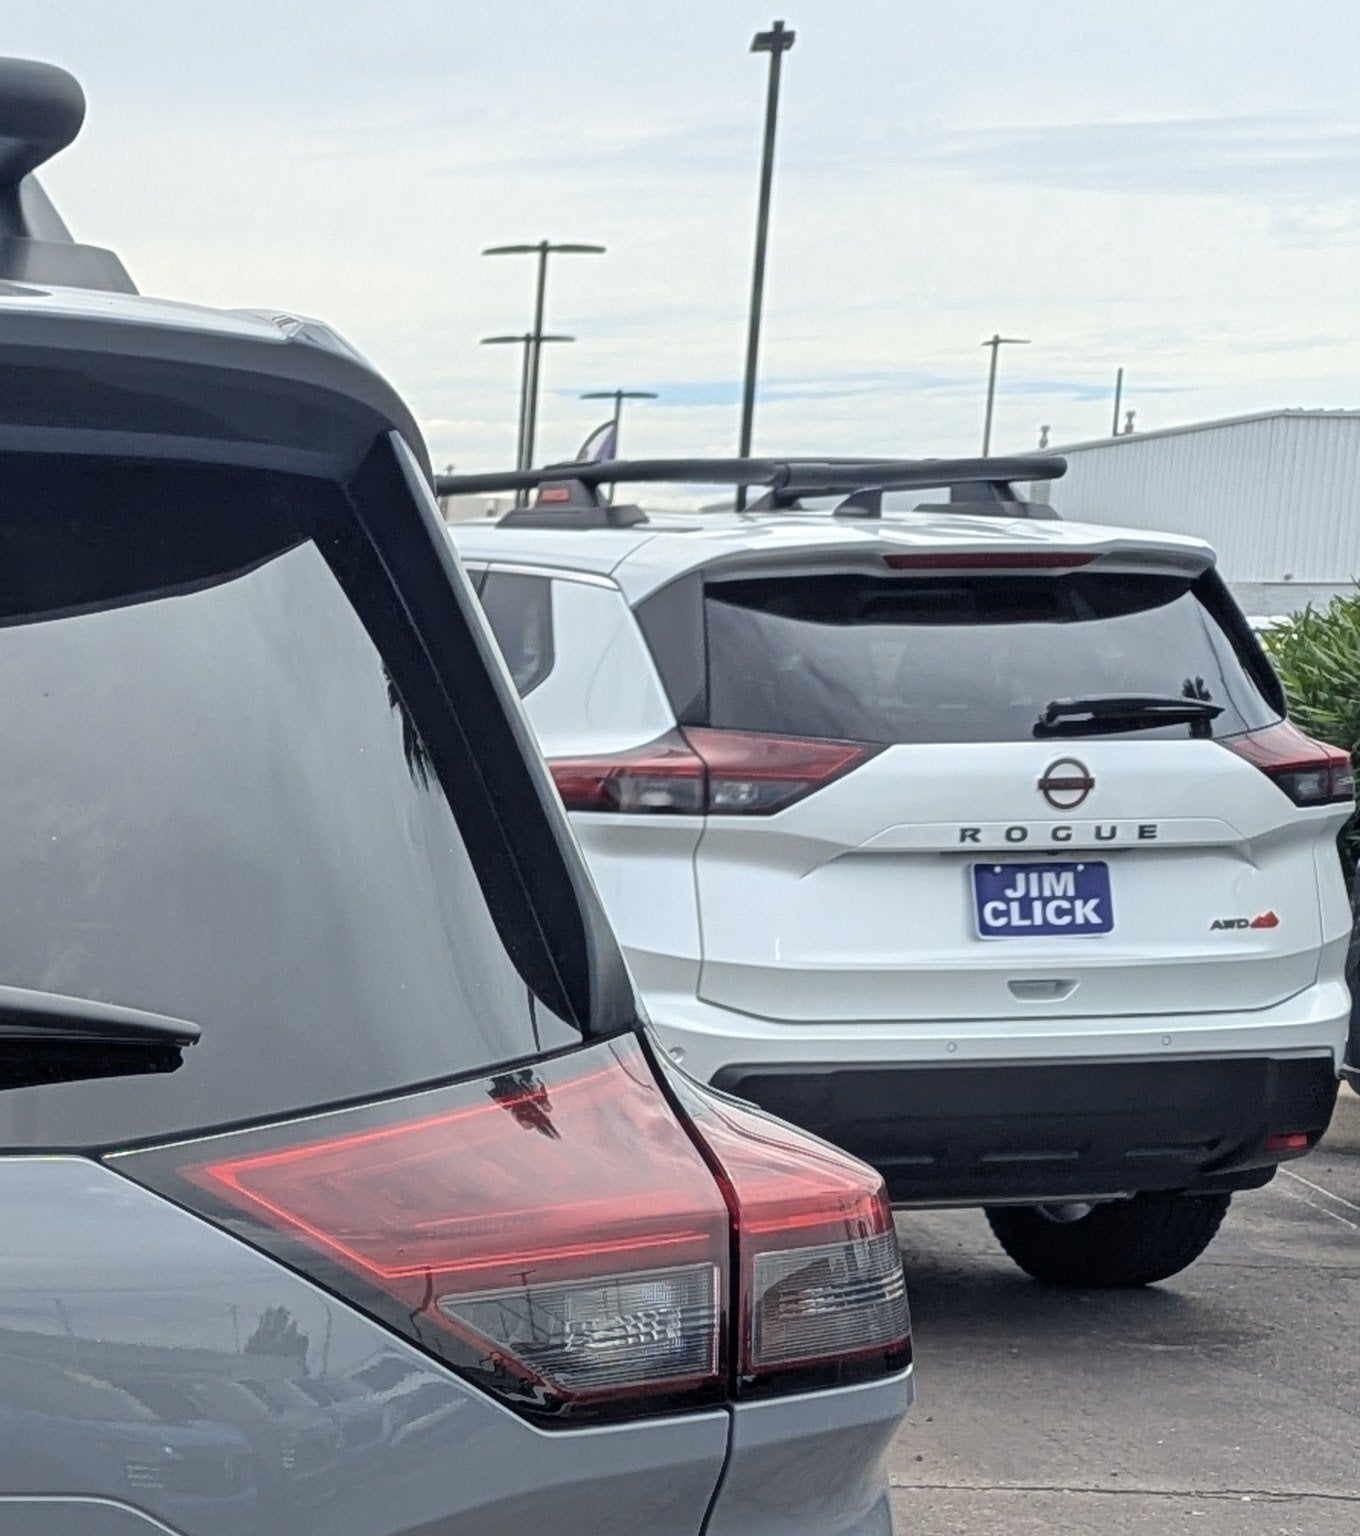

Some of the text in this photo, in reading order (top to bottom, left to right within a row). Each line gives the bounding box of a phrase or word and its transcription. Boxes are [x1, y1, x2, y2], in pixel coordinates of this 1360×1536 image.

[959, 823, 1158, 844] ROGUE
[1004, 871, 1075, 898] JIM
[983, 898, 1102, 927] CLICK
[1209, 918, 1249, 930] AWD
